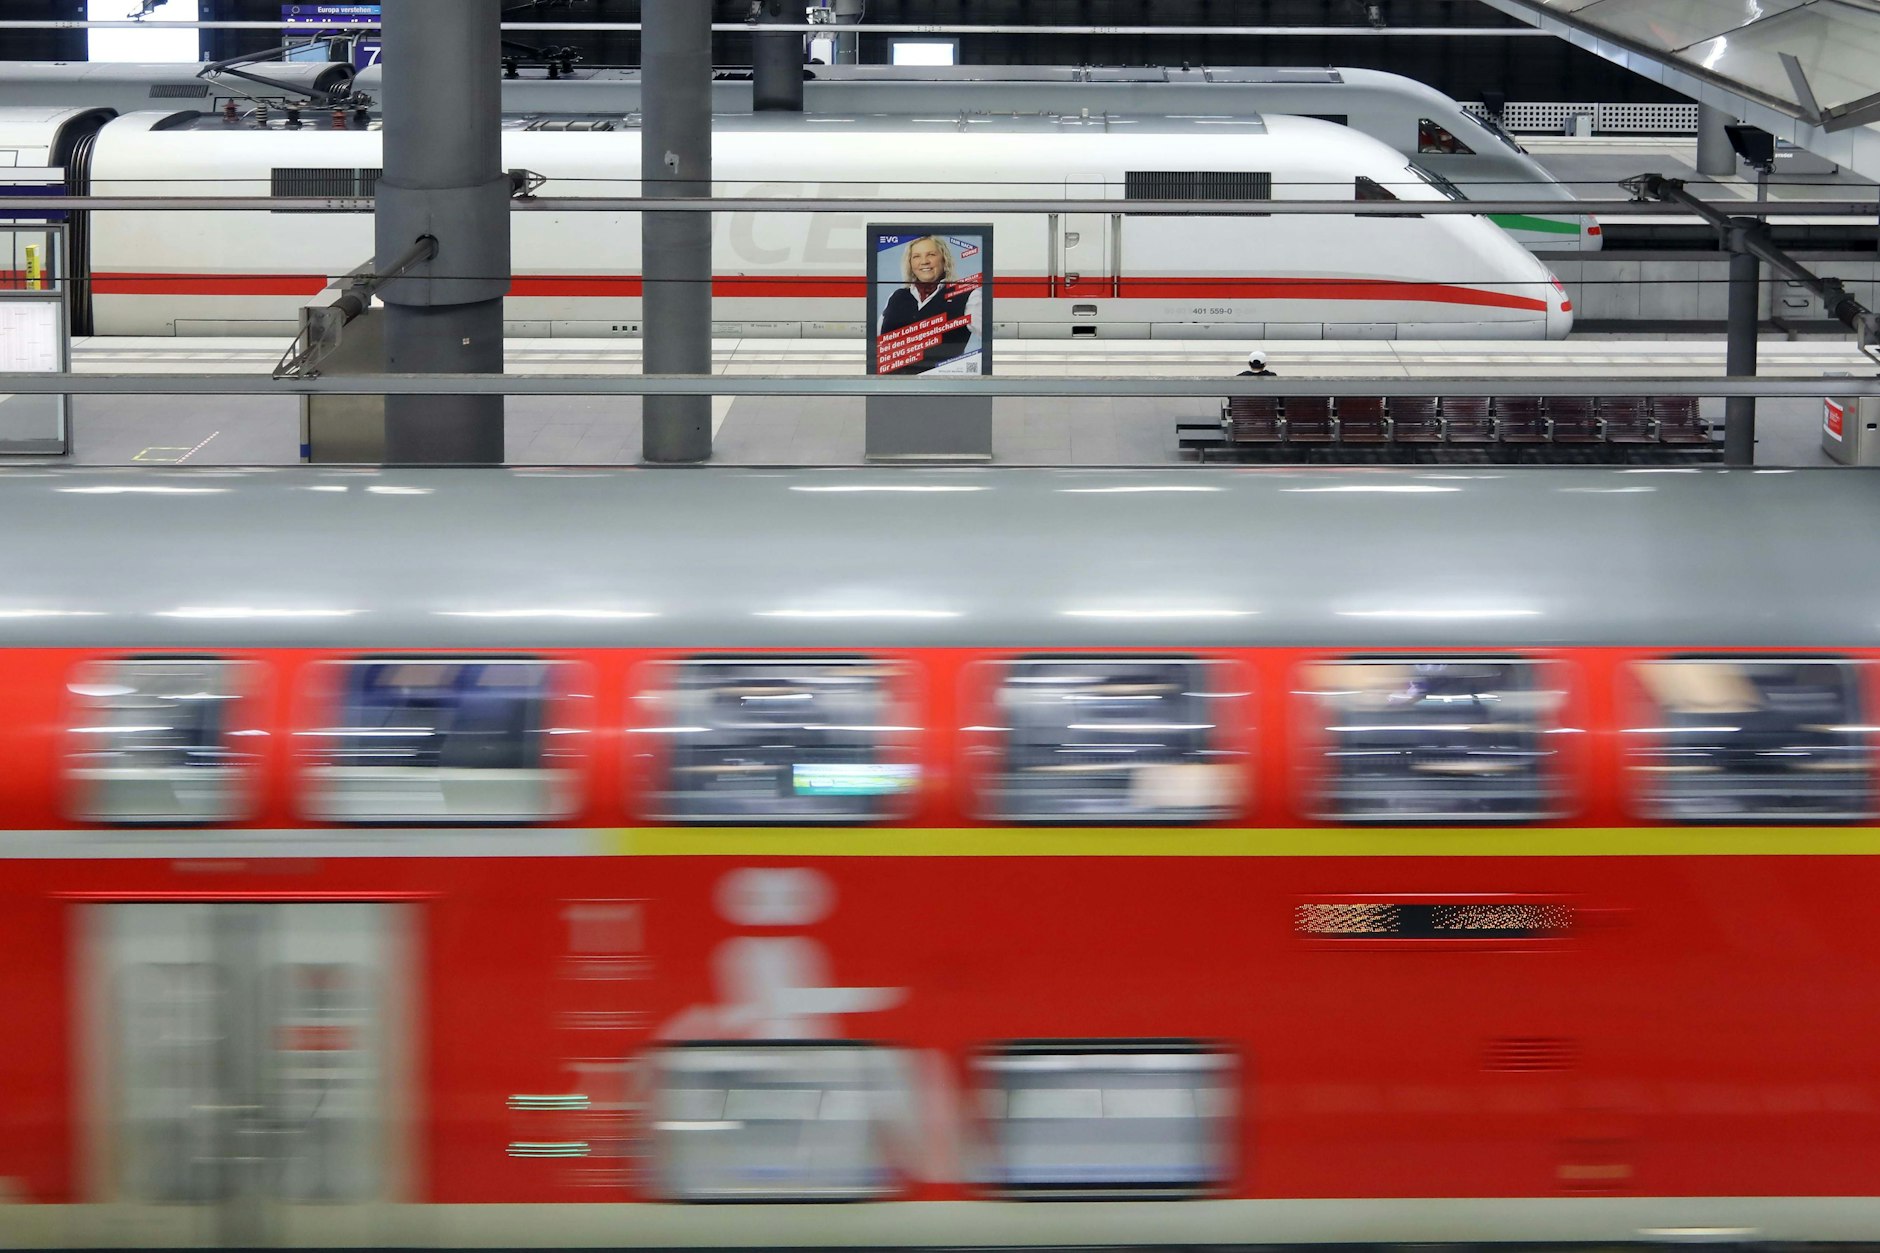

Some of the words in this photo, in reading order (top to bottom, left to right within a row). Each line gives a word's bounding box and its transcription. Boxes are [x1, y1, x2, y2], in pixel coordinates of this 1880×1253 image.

[317, 6, 339, 14] Europa
[364, 46, 381, 67] 7
[880, 343, 890, 353] bei
[892, 340, 905, 349] den
[906, 318, 969, 344] Busgesellschaften.
[901, 325, 918, 336] Lohn
[919, 321, 930, 329] für
[931, 316, 943, 325] uns
[880, 355, 891, 363] Die
[892, 349, 905, 358] EVG
[906, 343, 924, 353] setzt
[925, 337, 938, 347] sich
[880, 365, 890, 373] für
[891, 360, 904, 368] alle
